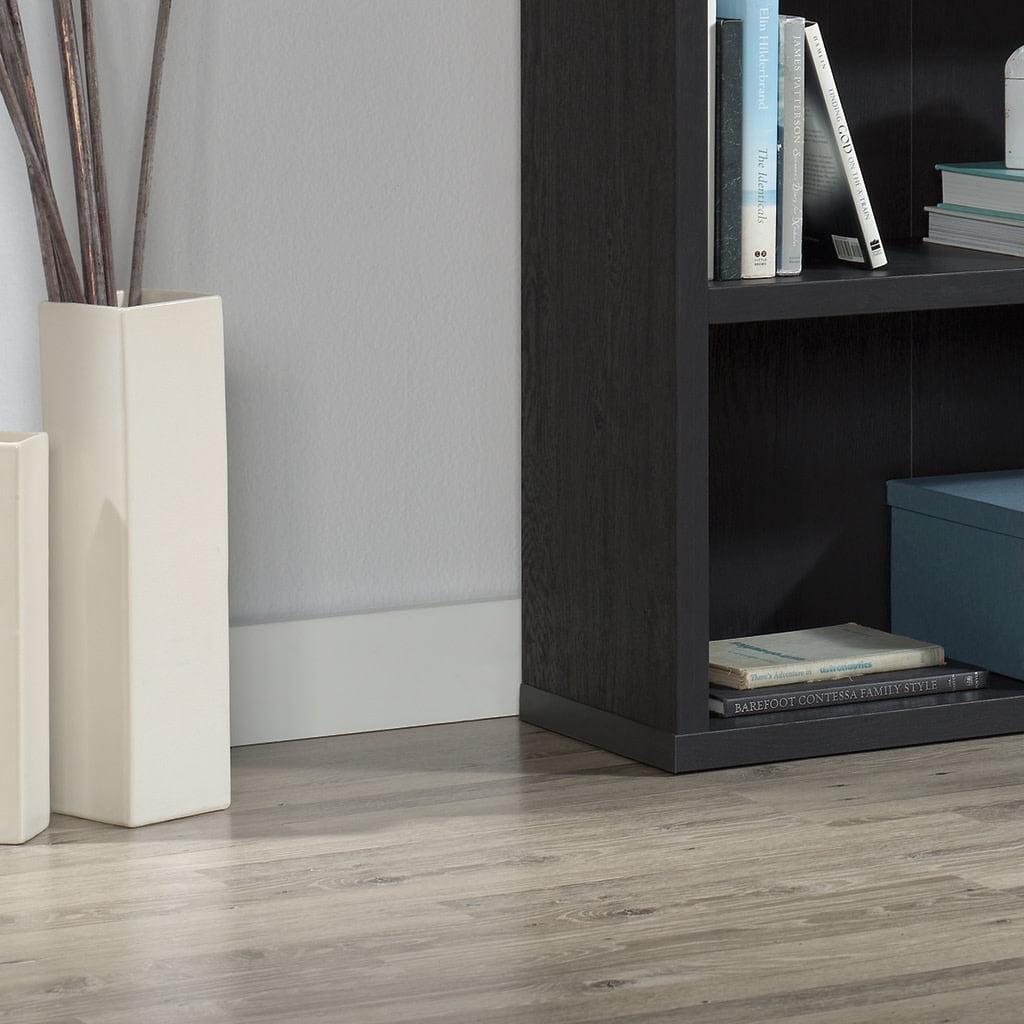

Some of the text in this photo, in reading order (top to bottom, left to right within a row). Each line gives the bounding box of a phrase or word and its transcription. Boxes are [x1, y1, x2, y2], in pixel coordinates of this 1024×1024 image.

[757, 7, 769, 110] Elin Hilderbrand
[793, 34, 802, 72] JAMES
[792, 75, 802, 144] PATTERSON
[828, 88, 842, 123] FINDING
[838, 123, 853, 157] GOD
[756, 148, 768, 224] The Identicals
[734, 696, 796, 714] BAREFOOT
[798, 691, 858, 706] CONTESSA
[860, 684, 901, 698] FAMILY
[903, 680, 938, 693] STYLE
